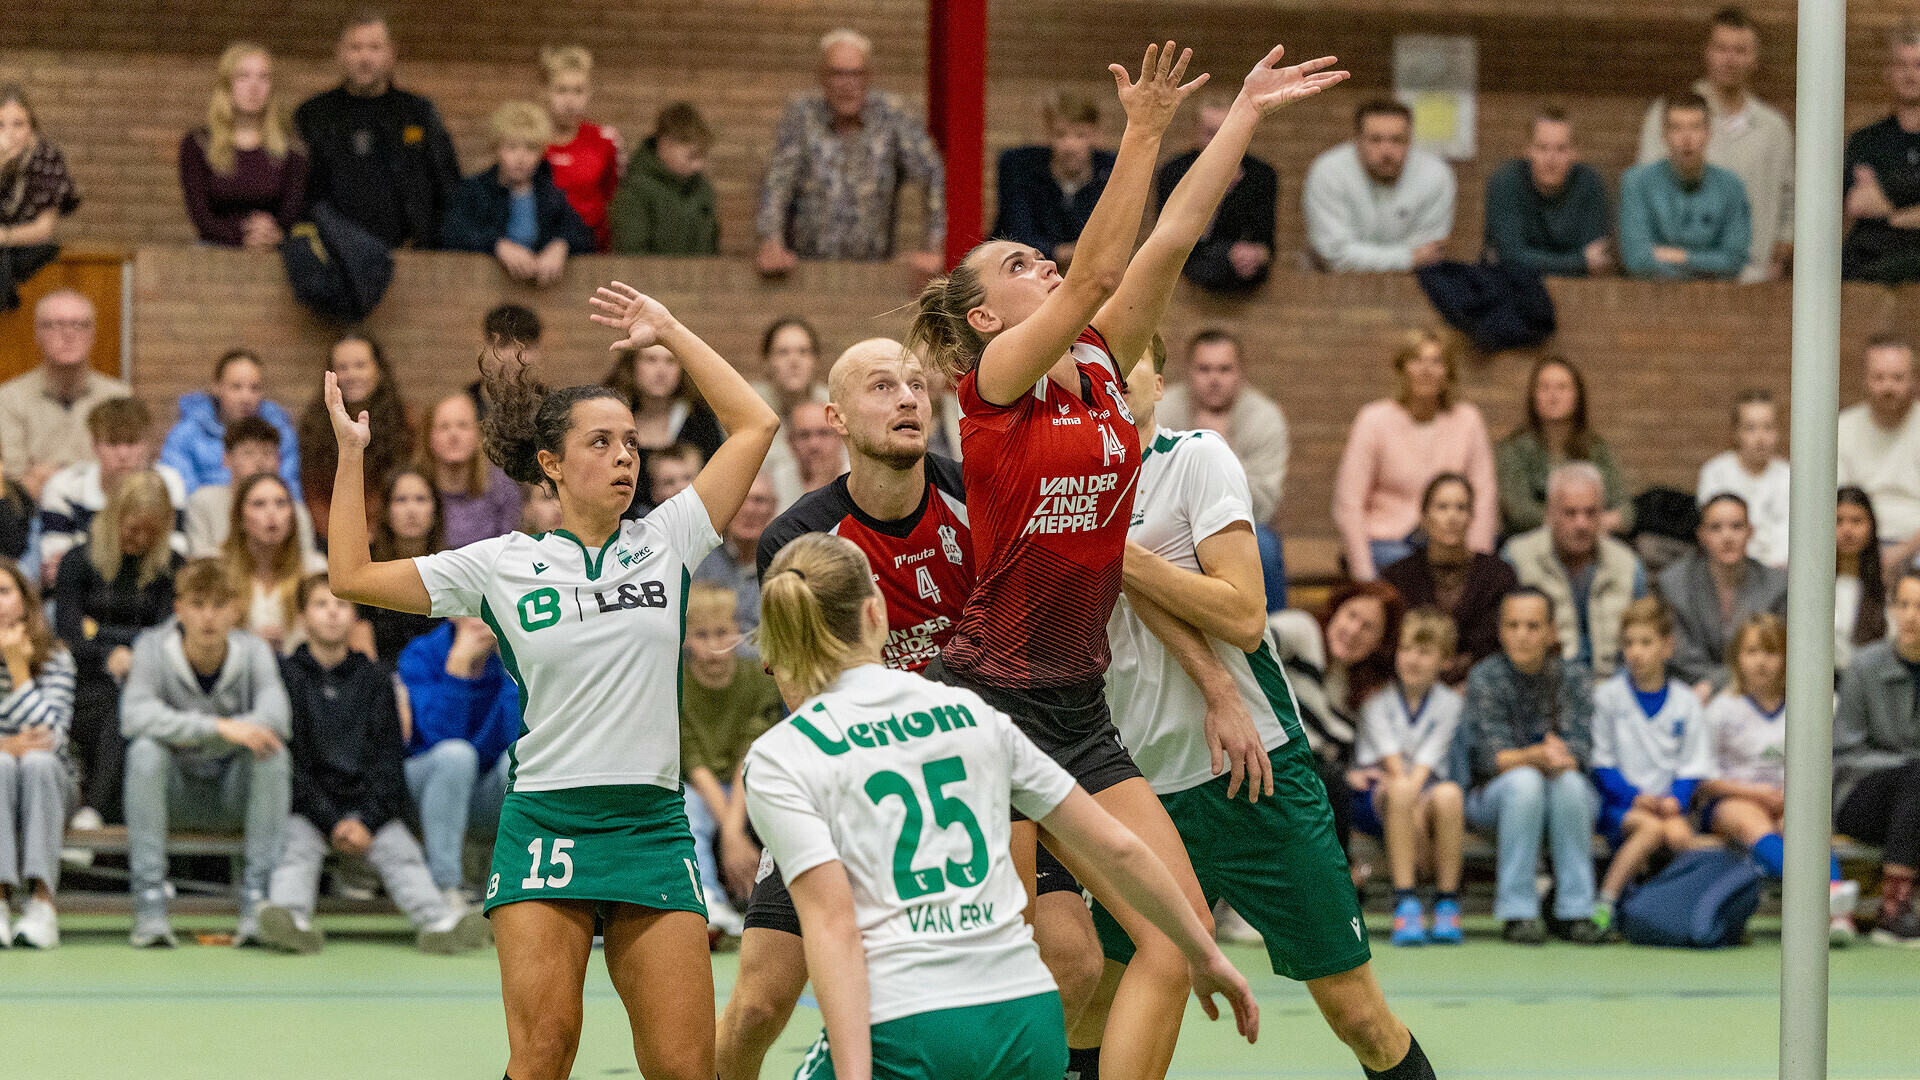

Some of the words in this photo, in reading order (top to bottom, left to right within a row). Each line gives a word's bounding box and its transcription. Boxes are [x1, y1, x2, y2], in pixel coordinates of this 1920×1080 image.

[1052, 416, 1082, 426] erima
[1097, 423, 1127, 467] 14
[1039, 475, 1085, 496] VAN
[1087, 472, 1118, 494] DER
[1032, 493, 1100, 517] LINDE
[1020, 512, 1099, 539] MEPPEL
[594, 580, 668, 614] L&B
[915, 565, 942, 605] 4
[910, 615, 952, 637] DER
[884, 635, 934, 660] INDE
[789, 701, 978, 756] Vertom
[863, 755, 990, 901] 25
[521, 837, 575, 890] 15
[905, 902, 955, 934] VAN
[959, 902, 997, 931] ERK
